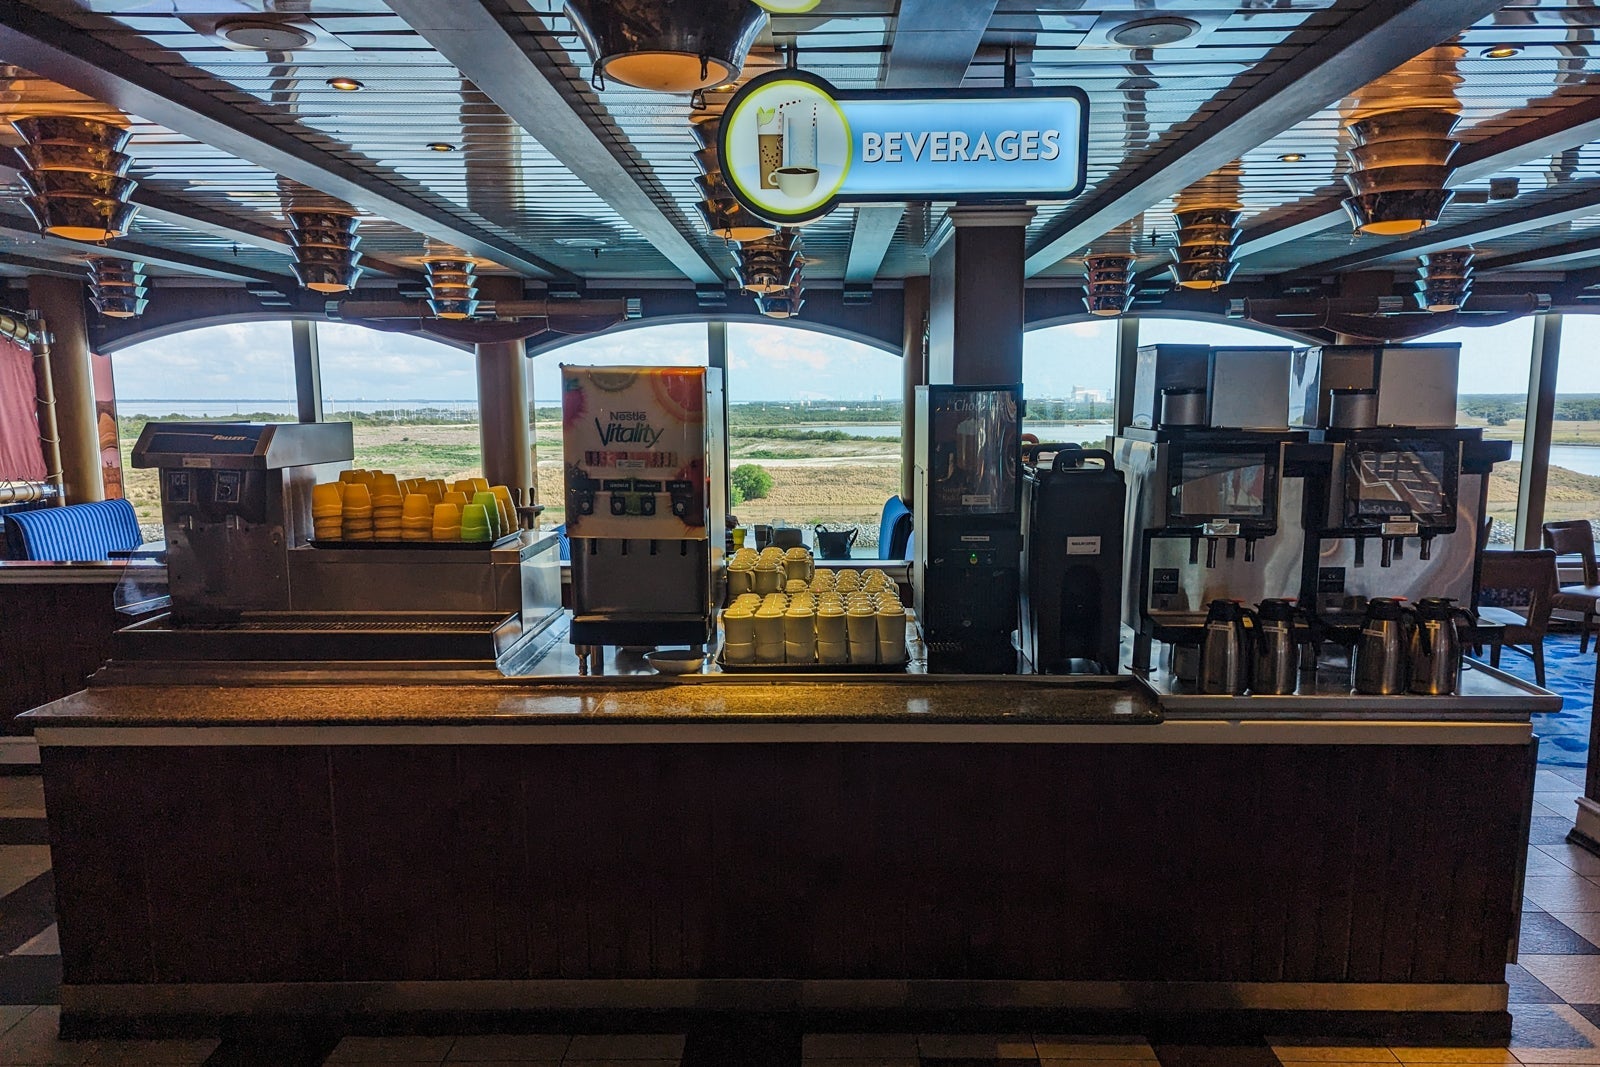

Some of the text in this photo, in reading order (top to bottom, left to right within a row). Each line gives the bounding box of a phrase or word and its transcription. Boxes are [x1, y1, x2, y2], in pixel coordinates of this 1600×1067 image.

[862, 129, 1060, 163] BEVERAGES
[594, 417, 664, 448] Vitality
[170, 474, 187, 485] ICE
